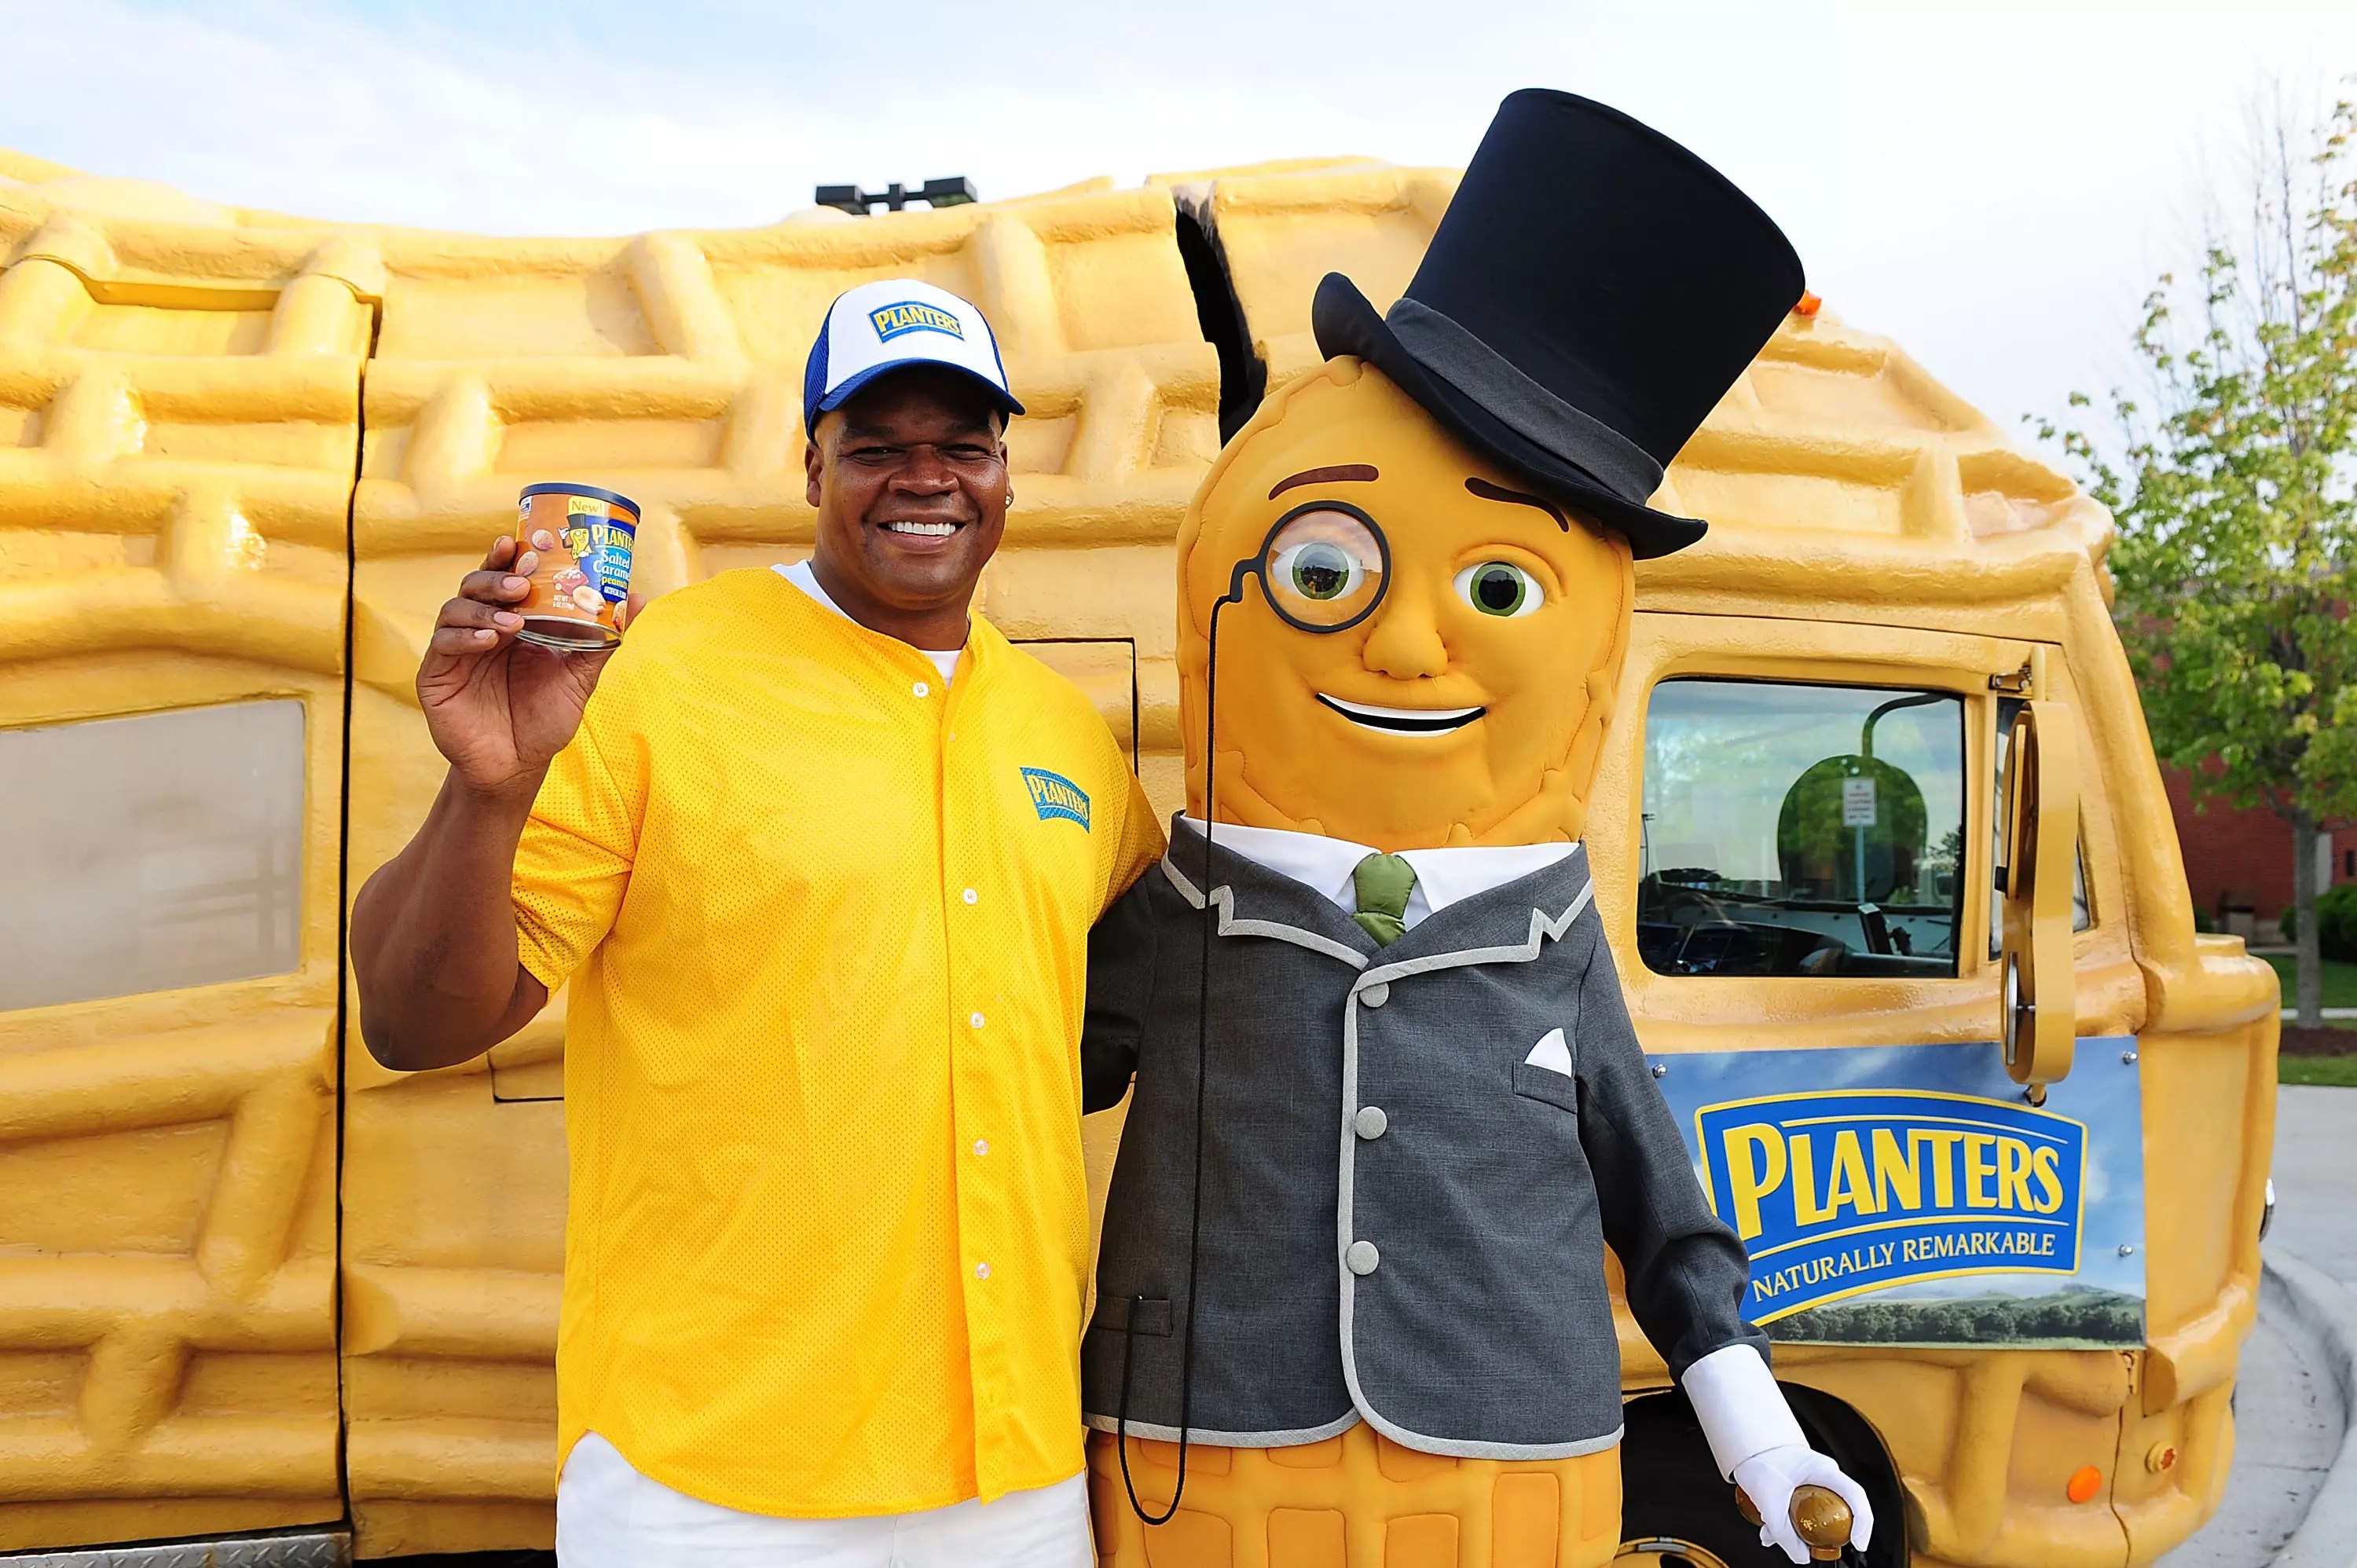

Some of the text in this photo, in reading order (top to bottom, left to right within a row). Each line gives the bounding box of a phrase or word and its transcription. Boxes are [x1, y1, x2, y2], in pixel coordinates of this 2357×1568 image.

[874, 306, 961, 334] PLANTERS
[572, 500, 603, 515] New!
[592, 524, 634, 552] PLANTE
[593, 560, 631, 581] Caram
[600, 549, 631, 570] Salted
[1026, 775, 1089, 821] PLANTERS
[1722, 1123, 2064, 1241] PLANTERS
[1751, 1231, 2056, 1304] NATURALLY REMARKABLE
